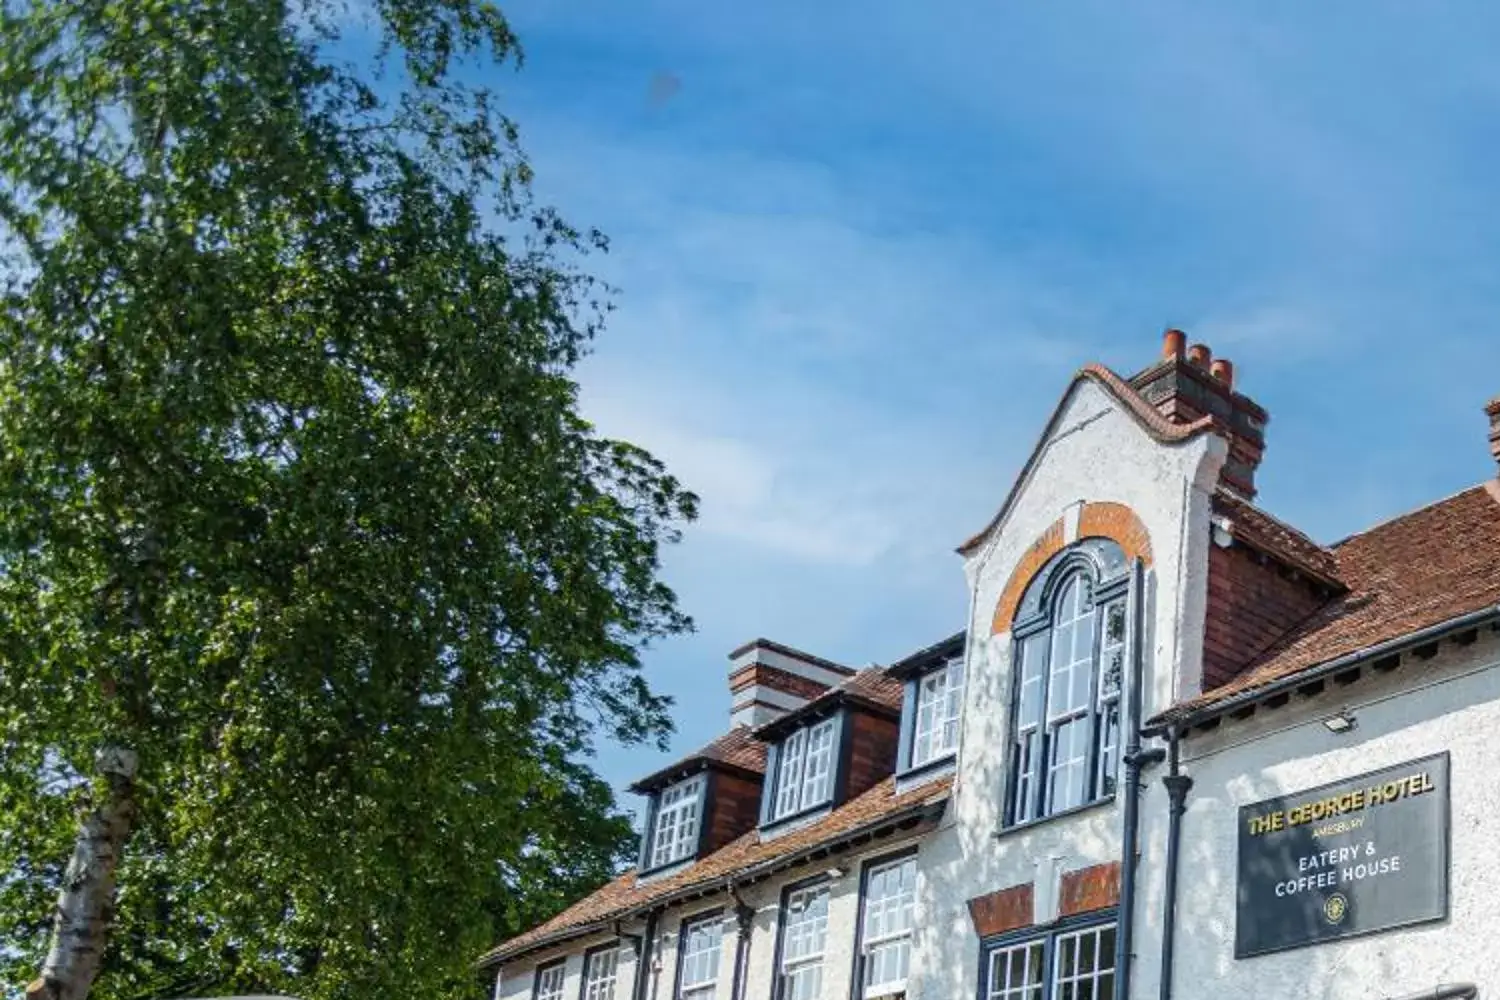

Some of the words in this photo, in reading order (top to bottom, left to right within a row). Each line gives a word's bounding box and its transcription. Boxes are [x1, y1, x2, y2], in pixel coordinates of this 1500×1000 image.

[1248, 811, 1284, 836] THE
[1288, 790, 1364, 826] GEORGE
[1368, 772, 1434, 805] HOTEL
[1275, 871, 1337, 897] COFFEE
[1342, 855, 1401, 883] HOUSE
[1299, 844, 1359, 872] EATERY
[1365, 841, 1376, 856] &
